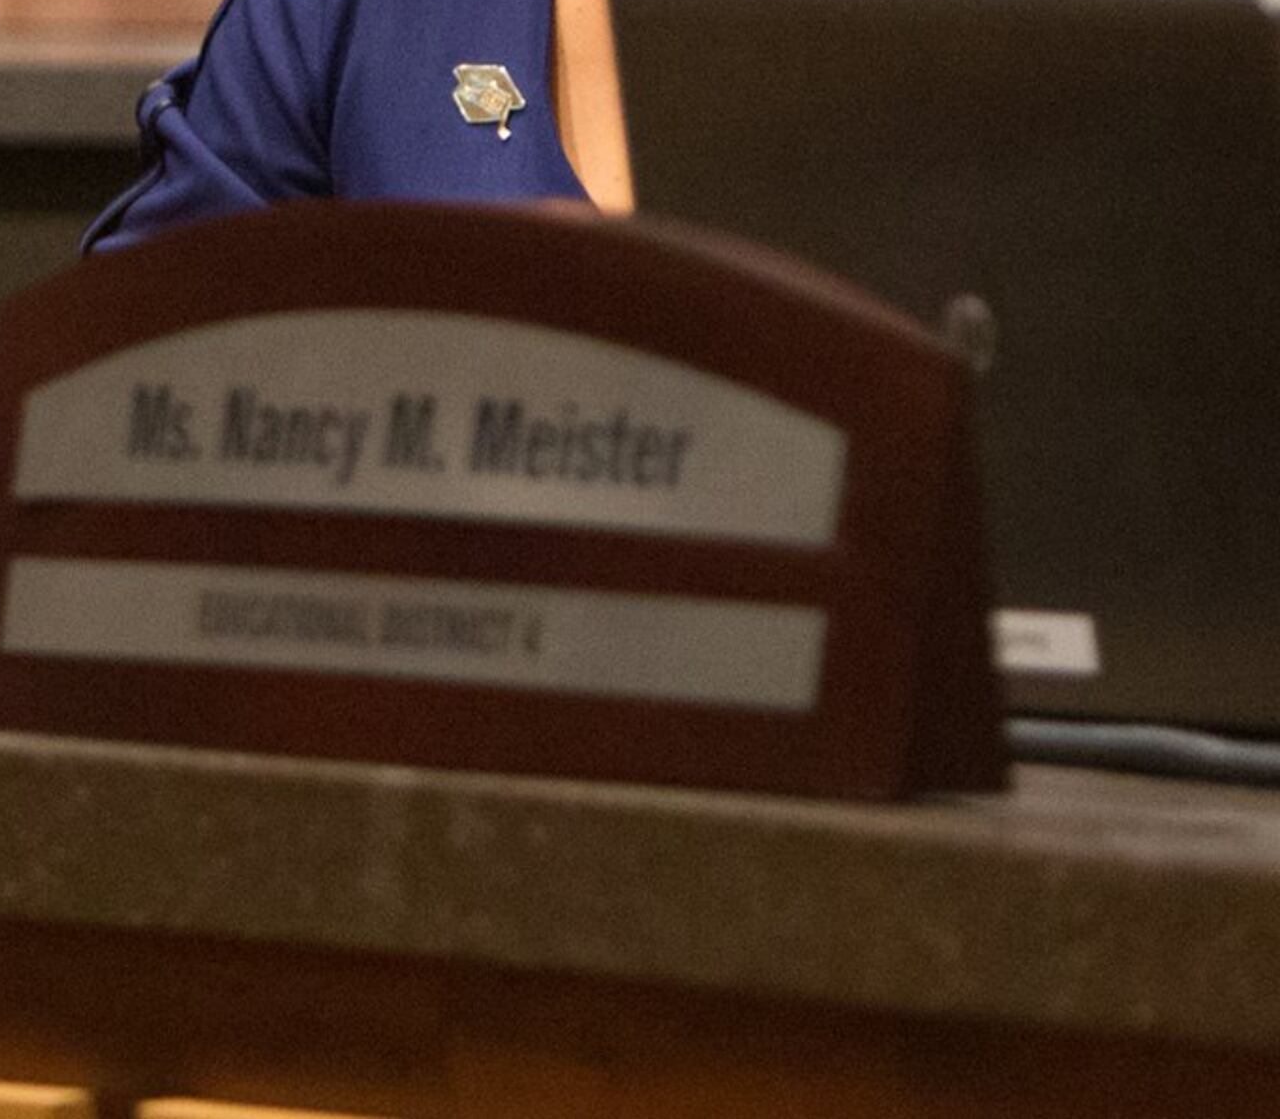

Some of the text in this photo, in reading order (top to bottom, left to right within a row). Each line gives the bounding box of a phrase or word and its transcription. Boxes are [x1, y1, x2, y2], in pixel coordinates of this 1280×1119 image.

[127, 383, 693, 488] Ms. Nancy M. Meister
